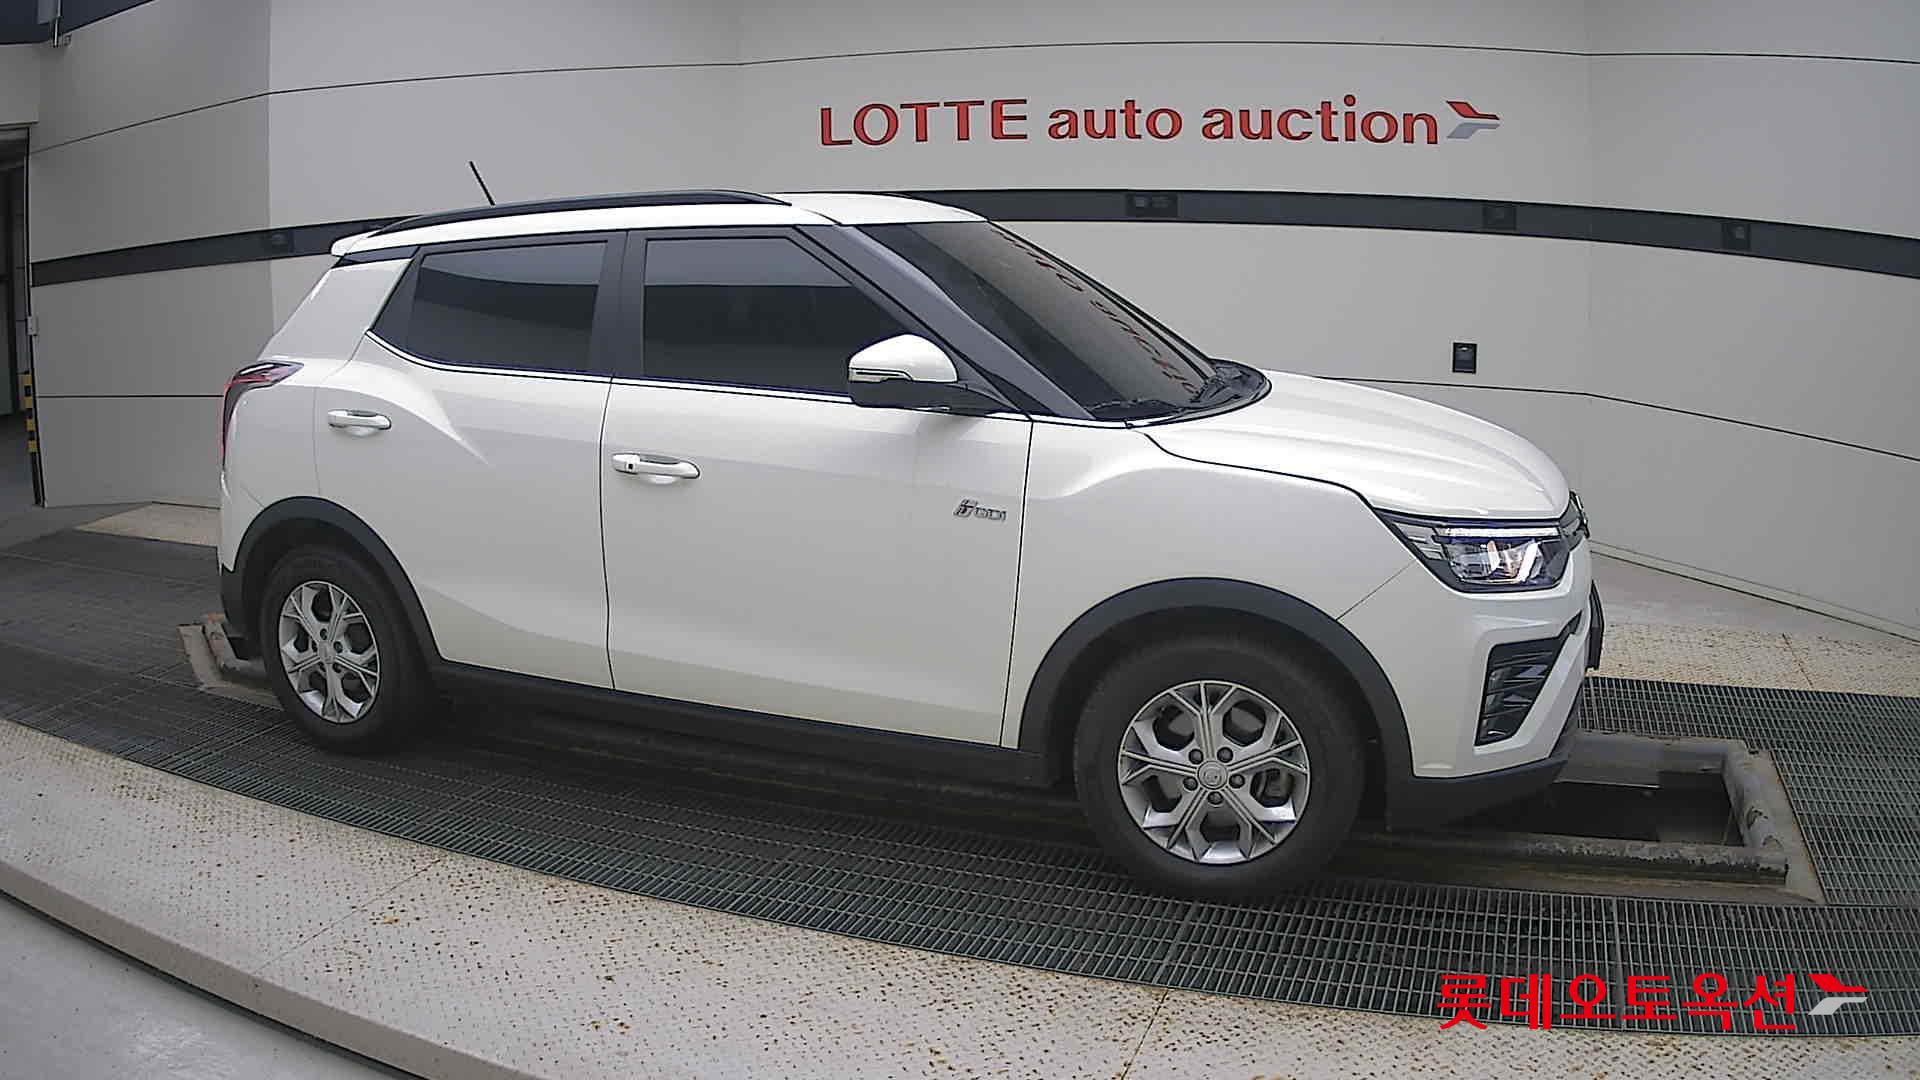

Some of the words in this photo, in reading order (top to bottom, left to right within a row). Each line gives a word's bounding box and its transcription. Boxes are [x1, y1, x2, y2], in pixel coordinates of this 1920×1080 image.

[820, 99, 1028, 146] LOTTE
[1047, 100, 1184, 140] auto
[1201, 94, 1439, 144] auction
